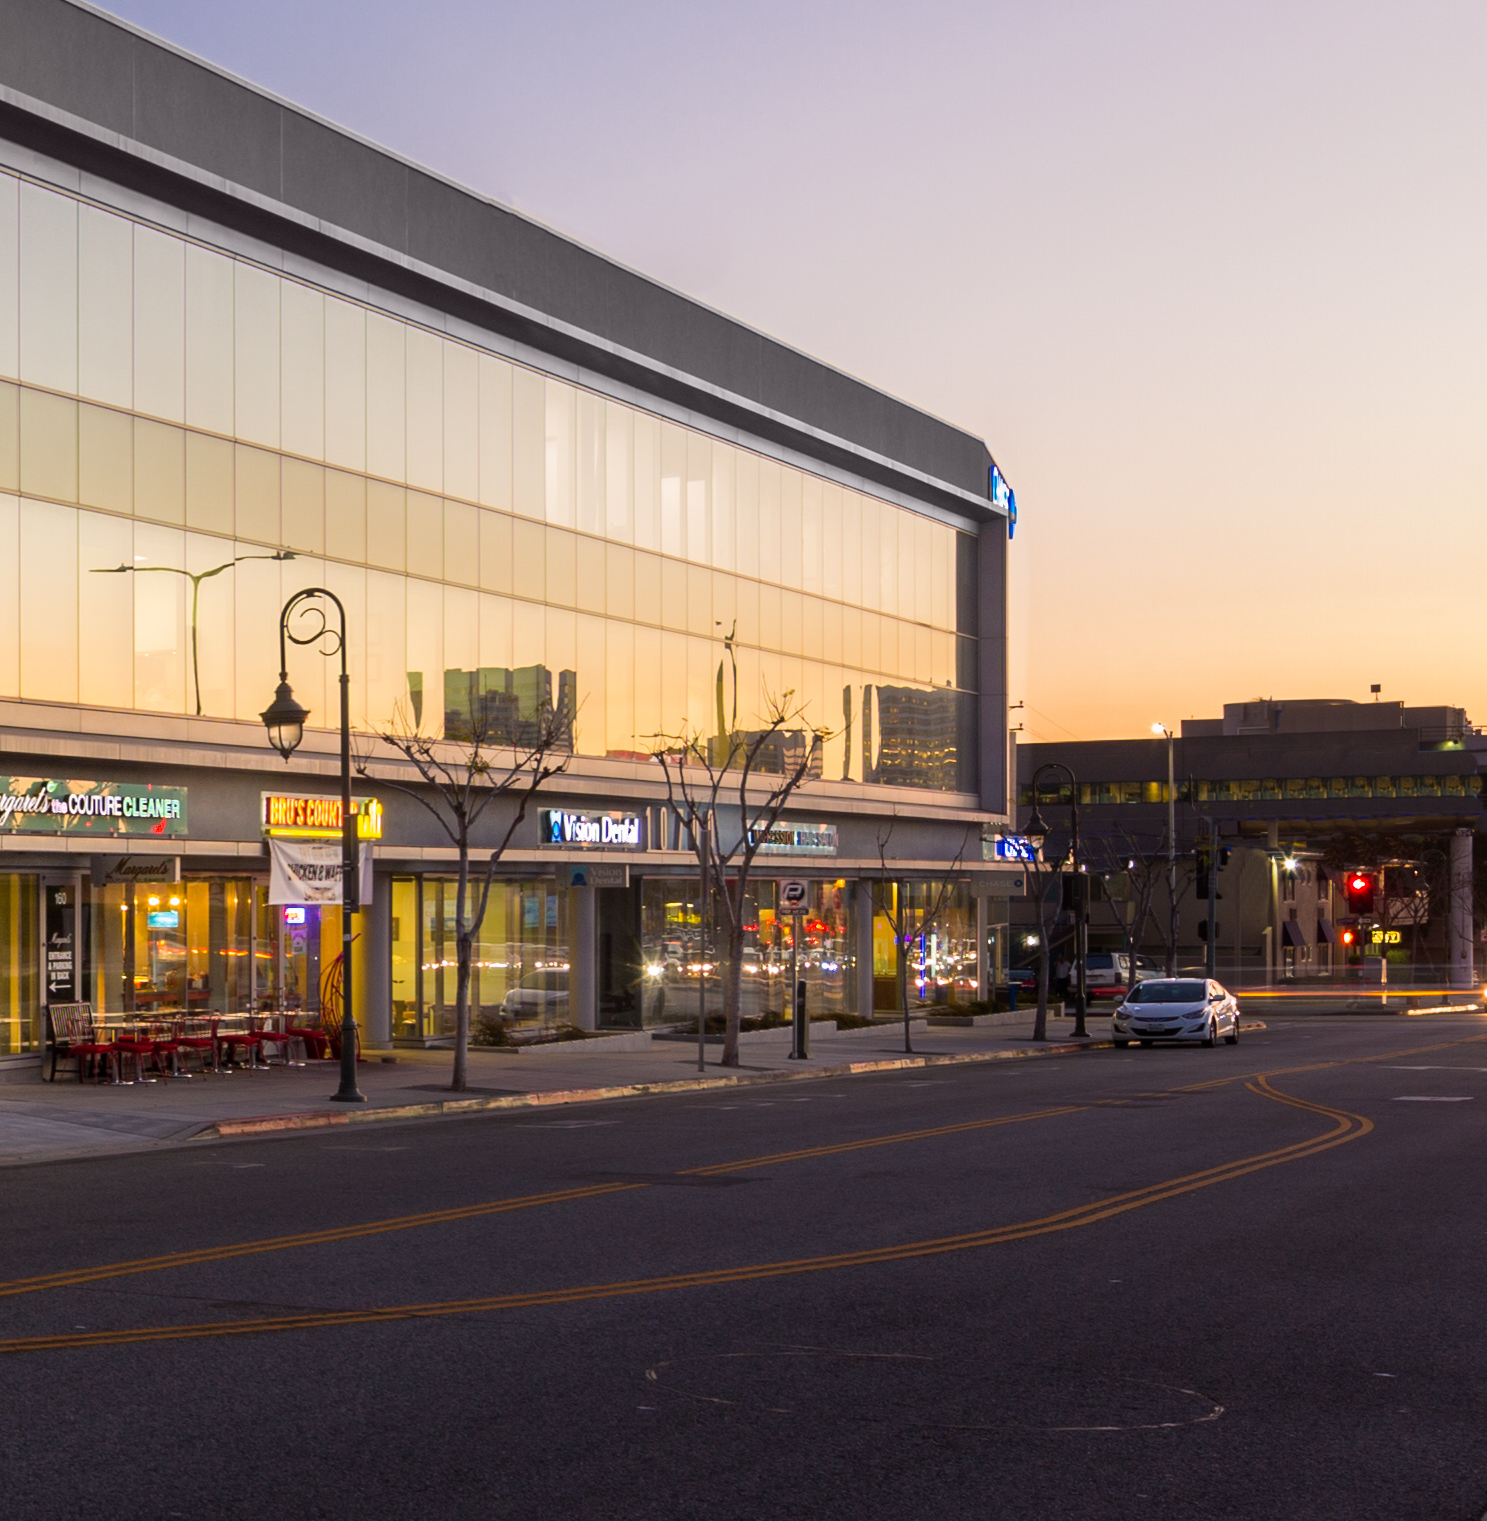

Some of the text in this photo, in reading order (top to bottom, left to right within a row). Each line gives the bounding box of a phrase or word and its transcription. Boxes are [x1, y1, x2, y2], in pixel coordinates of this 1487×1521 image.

[51, 797, 68, 815] the
[68, 794, 122, 816] COUTURE
[122, 795, 181, 819] CLEANER
[270, 797, 305, 826] BRU'S
[563, 814, 640, 844] Vision Dental
[590, 867, 623, 876] Vision
[590, 876, 623, 885] Dental
[54, 892, 68, 905] 160
